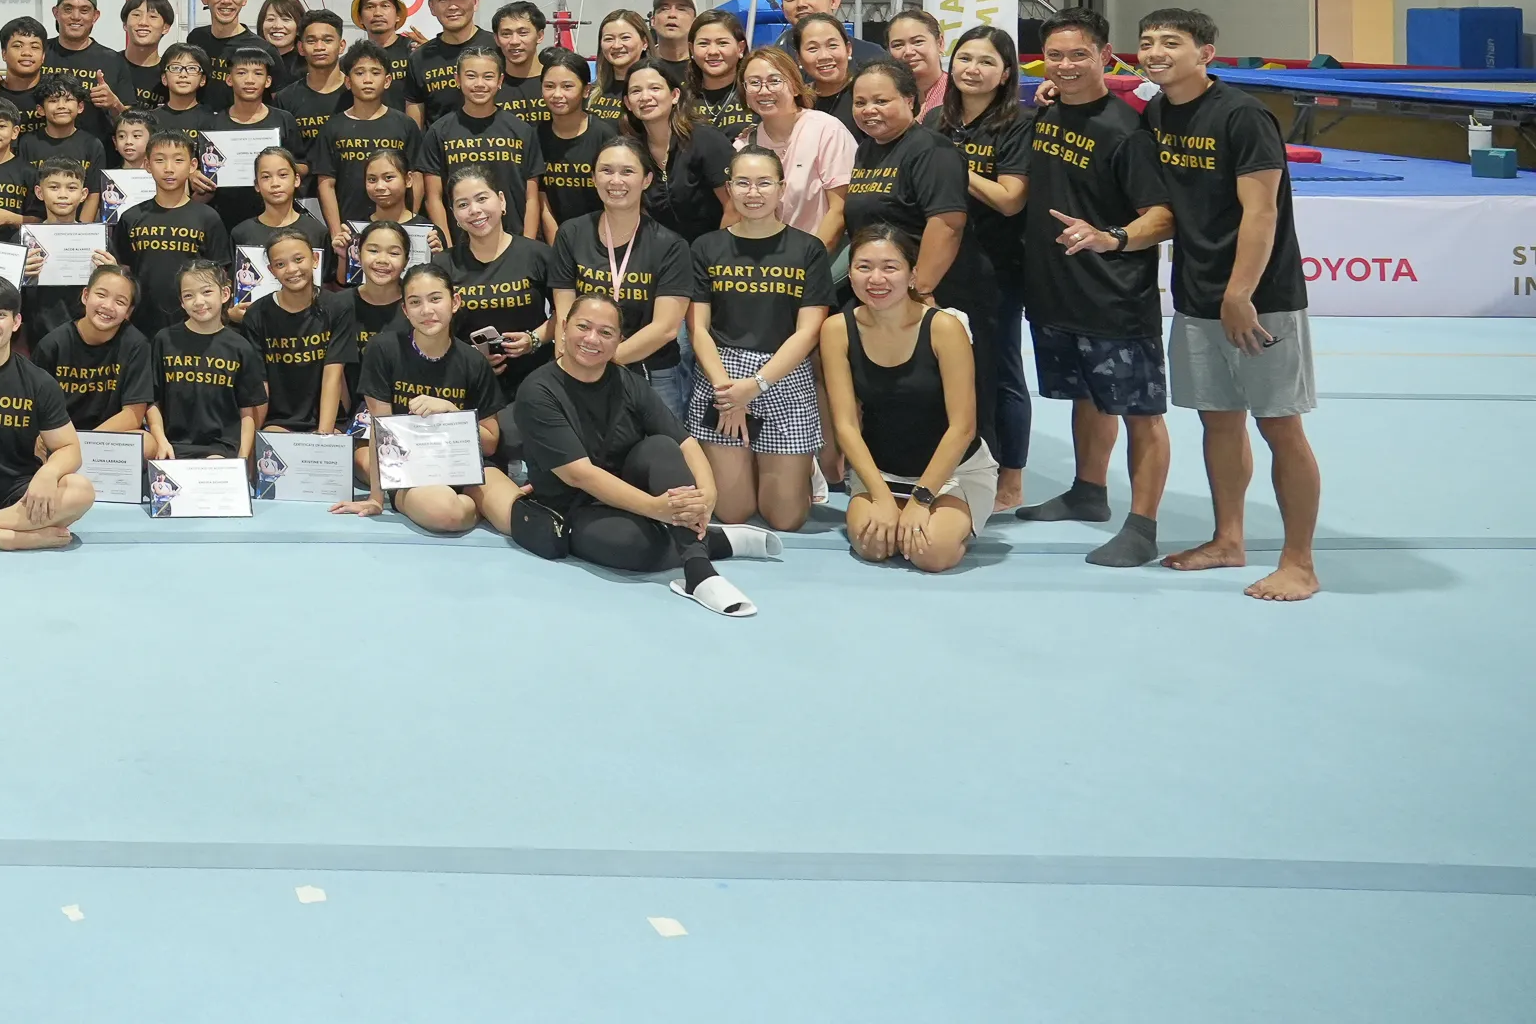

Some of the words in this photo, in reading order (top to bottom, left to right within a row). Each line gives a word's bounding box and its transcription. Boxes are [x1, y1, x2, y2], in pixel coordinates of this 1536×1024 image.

[336, 139, 369, 148] START
[373, 139, 404, 150] YOUR
[488, 138, 523, 149] YOUR
[965, 143, 993, 156] OUR
[1181, 136, 1216, 150] YOUR
[448, 151, 522, 164] MPOSSIBLE
[0, 184, 27, 196] YOUR
[130, 226, 167, 237] START
[171, 227, 204, 241] YOUR
[708, 265, 754, 277] START
[761, 266, 805, 280] YOUR
[1300, 257, 1418, 282] OYOTA
[620, 272, 652, 284] YOU
[491, 279, 529, 294] YOUR
[710, 280, 803, 298] MPOSSIBLE
[459, 294, 531, 310] POSSIBLE
[266, 338, 297, 347] TART
[57, 366, 96, 378] START
[166, 371, 233, 387] MPOSSIBL
[395, 381, 431, 396] START
[436, 388, 465, 398] YOUR
